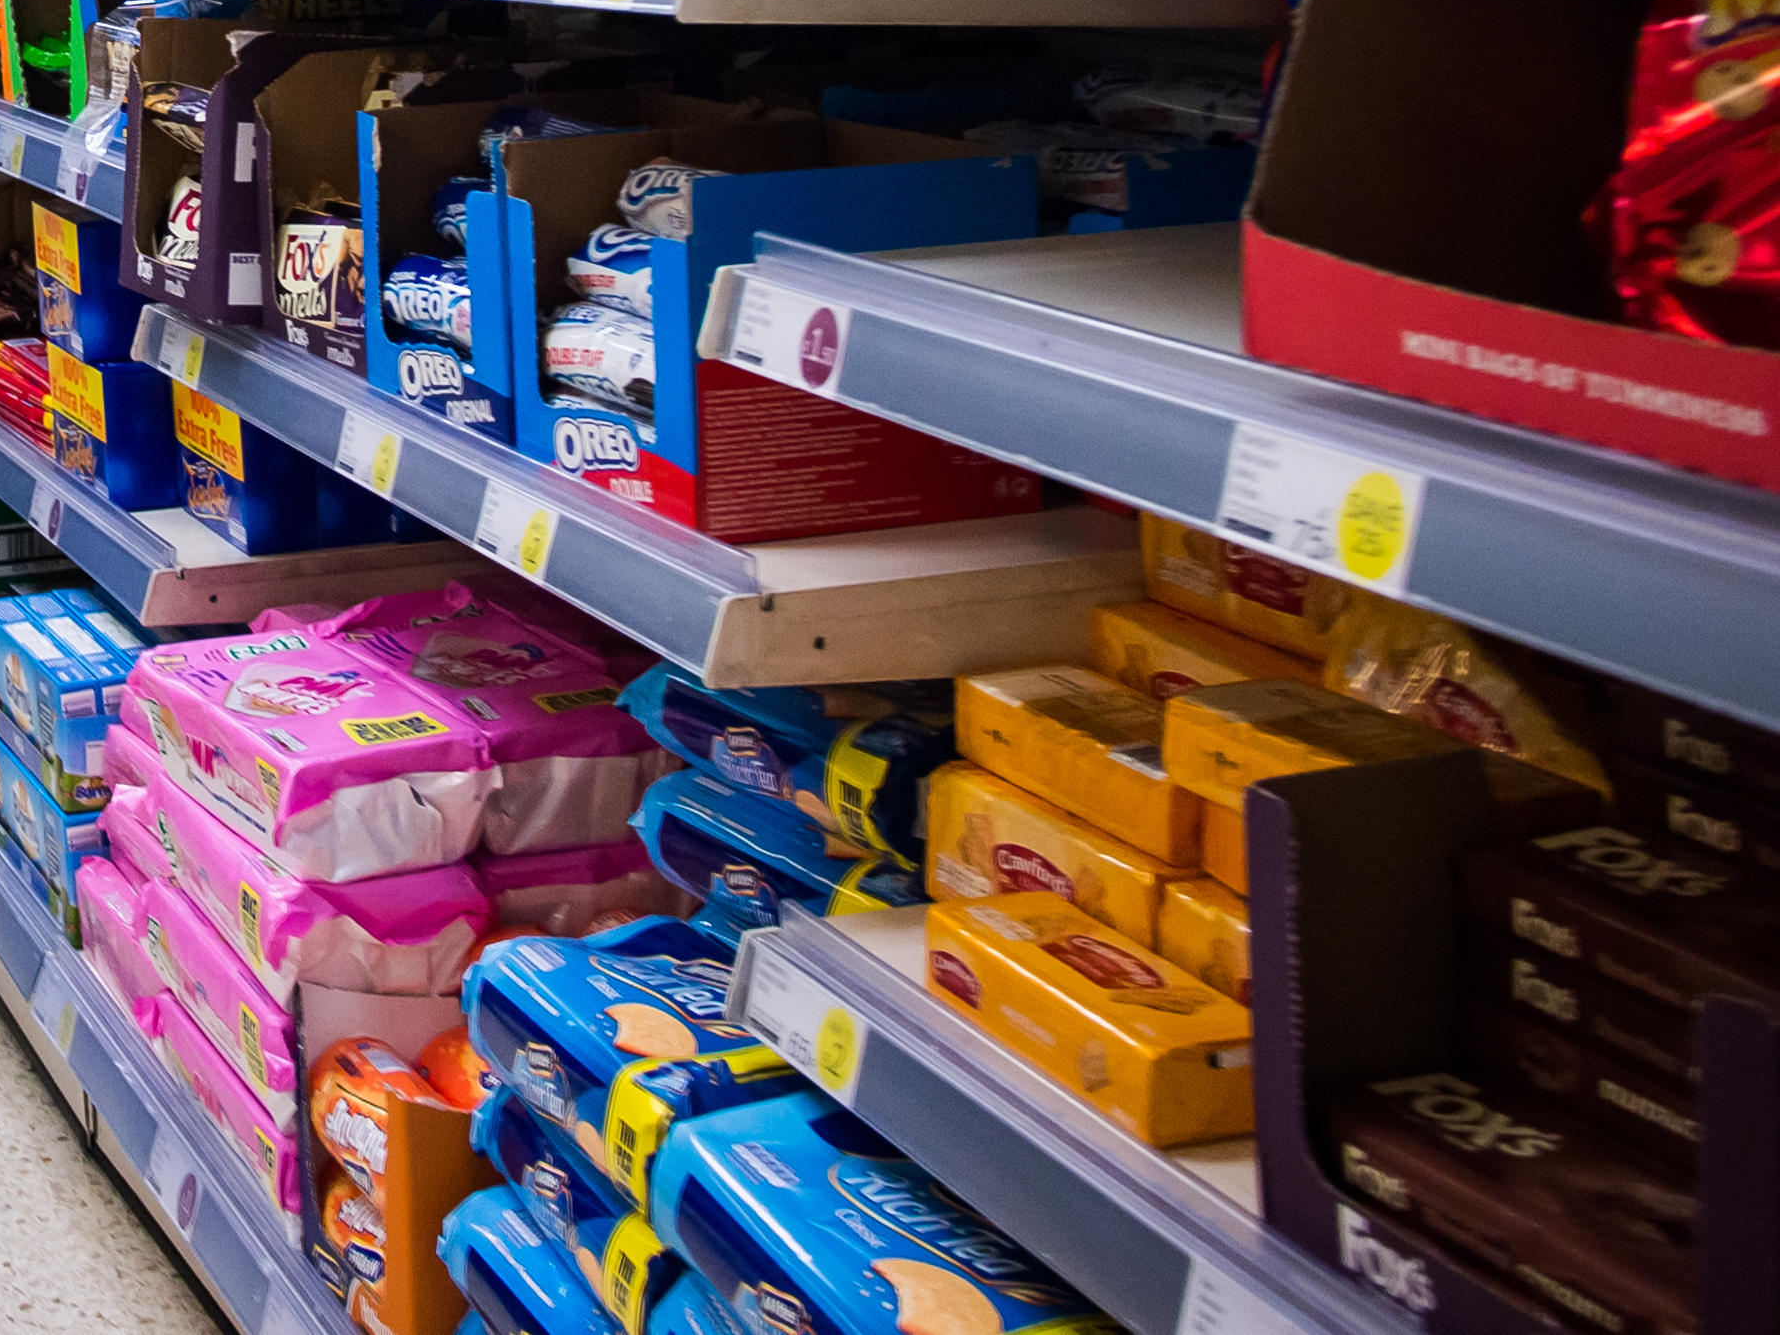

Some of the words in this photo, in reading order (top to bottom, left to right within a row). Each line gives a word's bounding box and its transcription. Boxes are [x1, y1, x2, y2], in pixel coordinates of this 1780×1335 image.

[232, 255, 255, 264] BEST
[51, 381, 77, 413] Extra
[78, 391, 102, 425] Free
[399, 349, 463, 403] OREO
[178, 409, 210, 445] Extra
[210, 427, 239, 466] Free
[555, 417, 637, 472] OREO
[839, 1169, 950, 1234] Rich
[937, 1225, 1030, 1276] Tea
